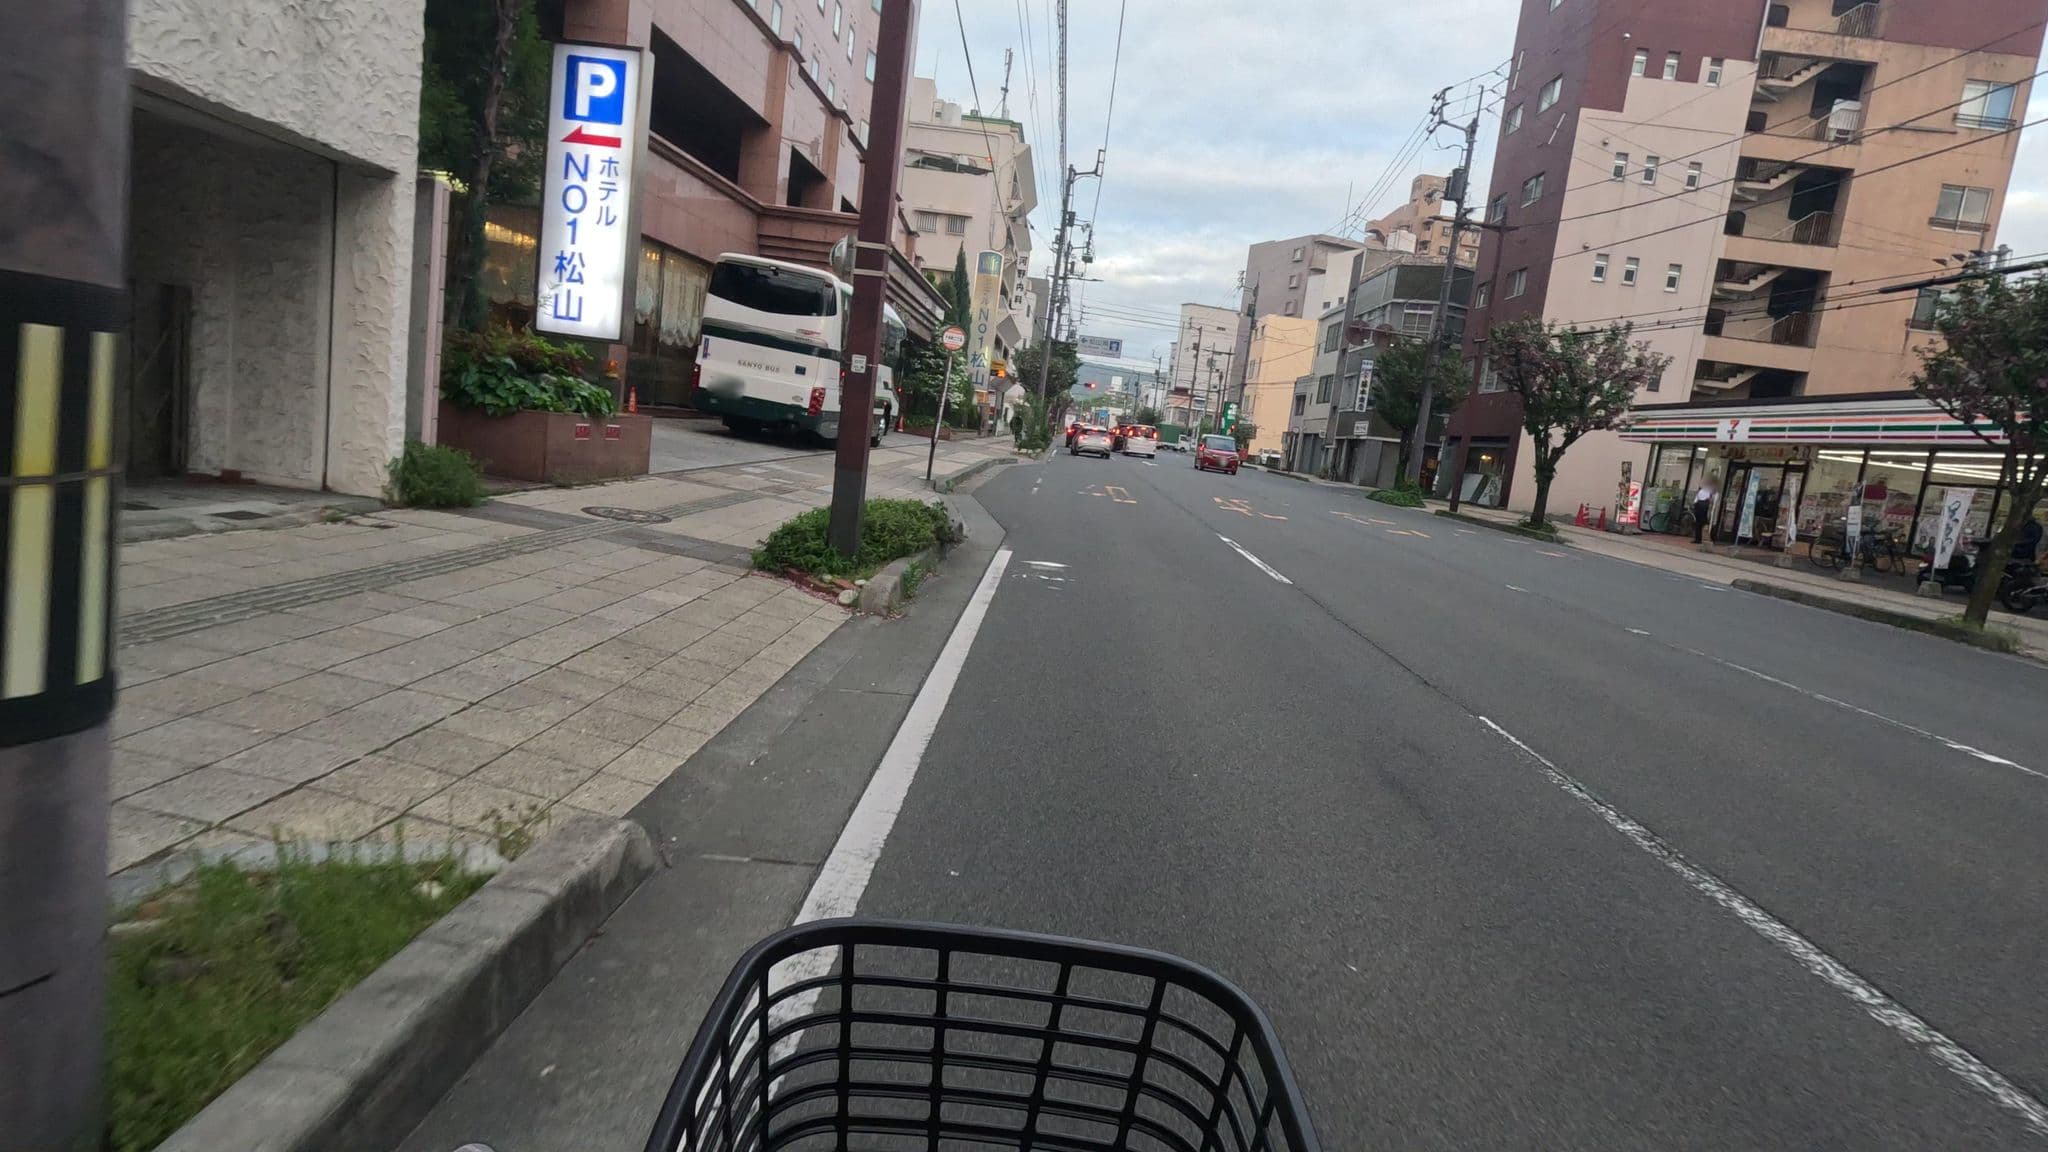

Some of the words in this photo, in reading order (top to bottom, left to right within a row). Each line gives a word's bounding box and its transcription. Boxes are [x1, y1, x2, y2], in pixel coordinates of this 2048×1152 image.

[576, 62, 617, 117] P
[596, 156, 619, 226] ホテル
[553, 152, 590, 322] NO1松山
